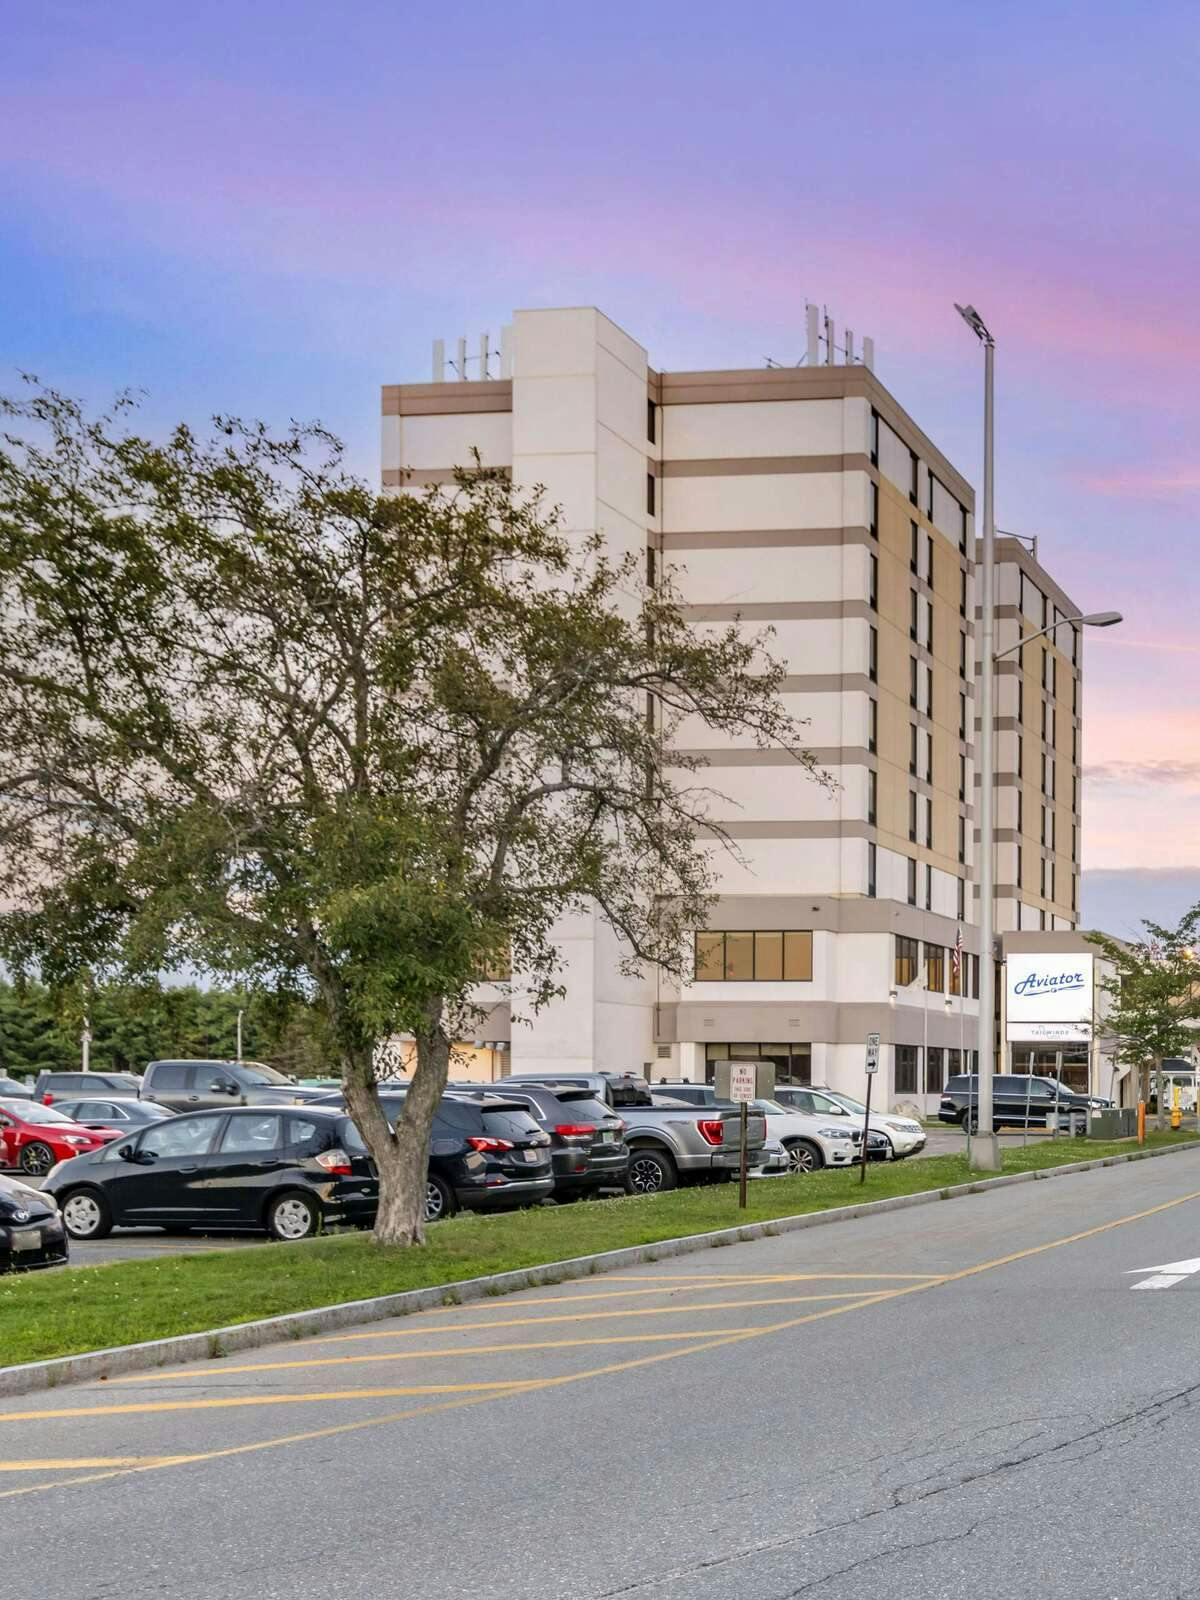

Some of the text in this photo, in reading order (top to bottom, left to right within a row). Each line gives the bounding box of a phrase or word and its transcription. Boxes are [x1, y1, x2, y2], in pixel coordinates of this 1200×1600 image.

[1014, 973, 1084, 994] Aviator
[869, 1036, 879, 1047] ONE
[868, 1048, 878, 1057] WAY
[732, 1076, 753, 1084] PARKING
